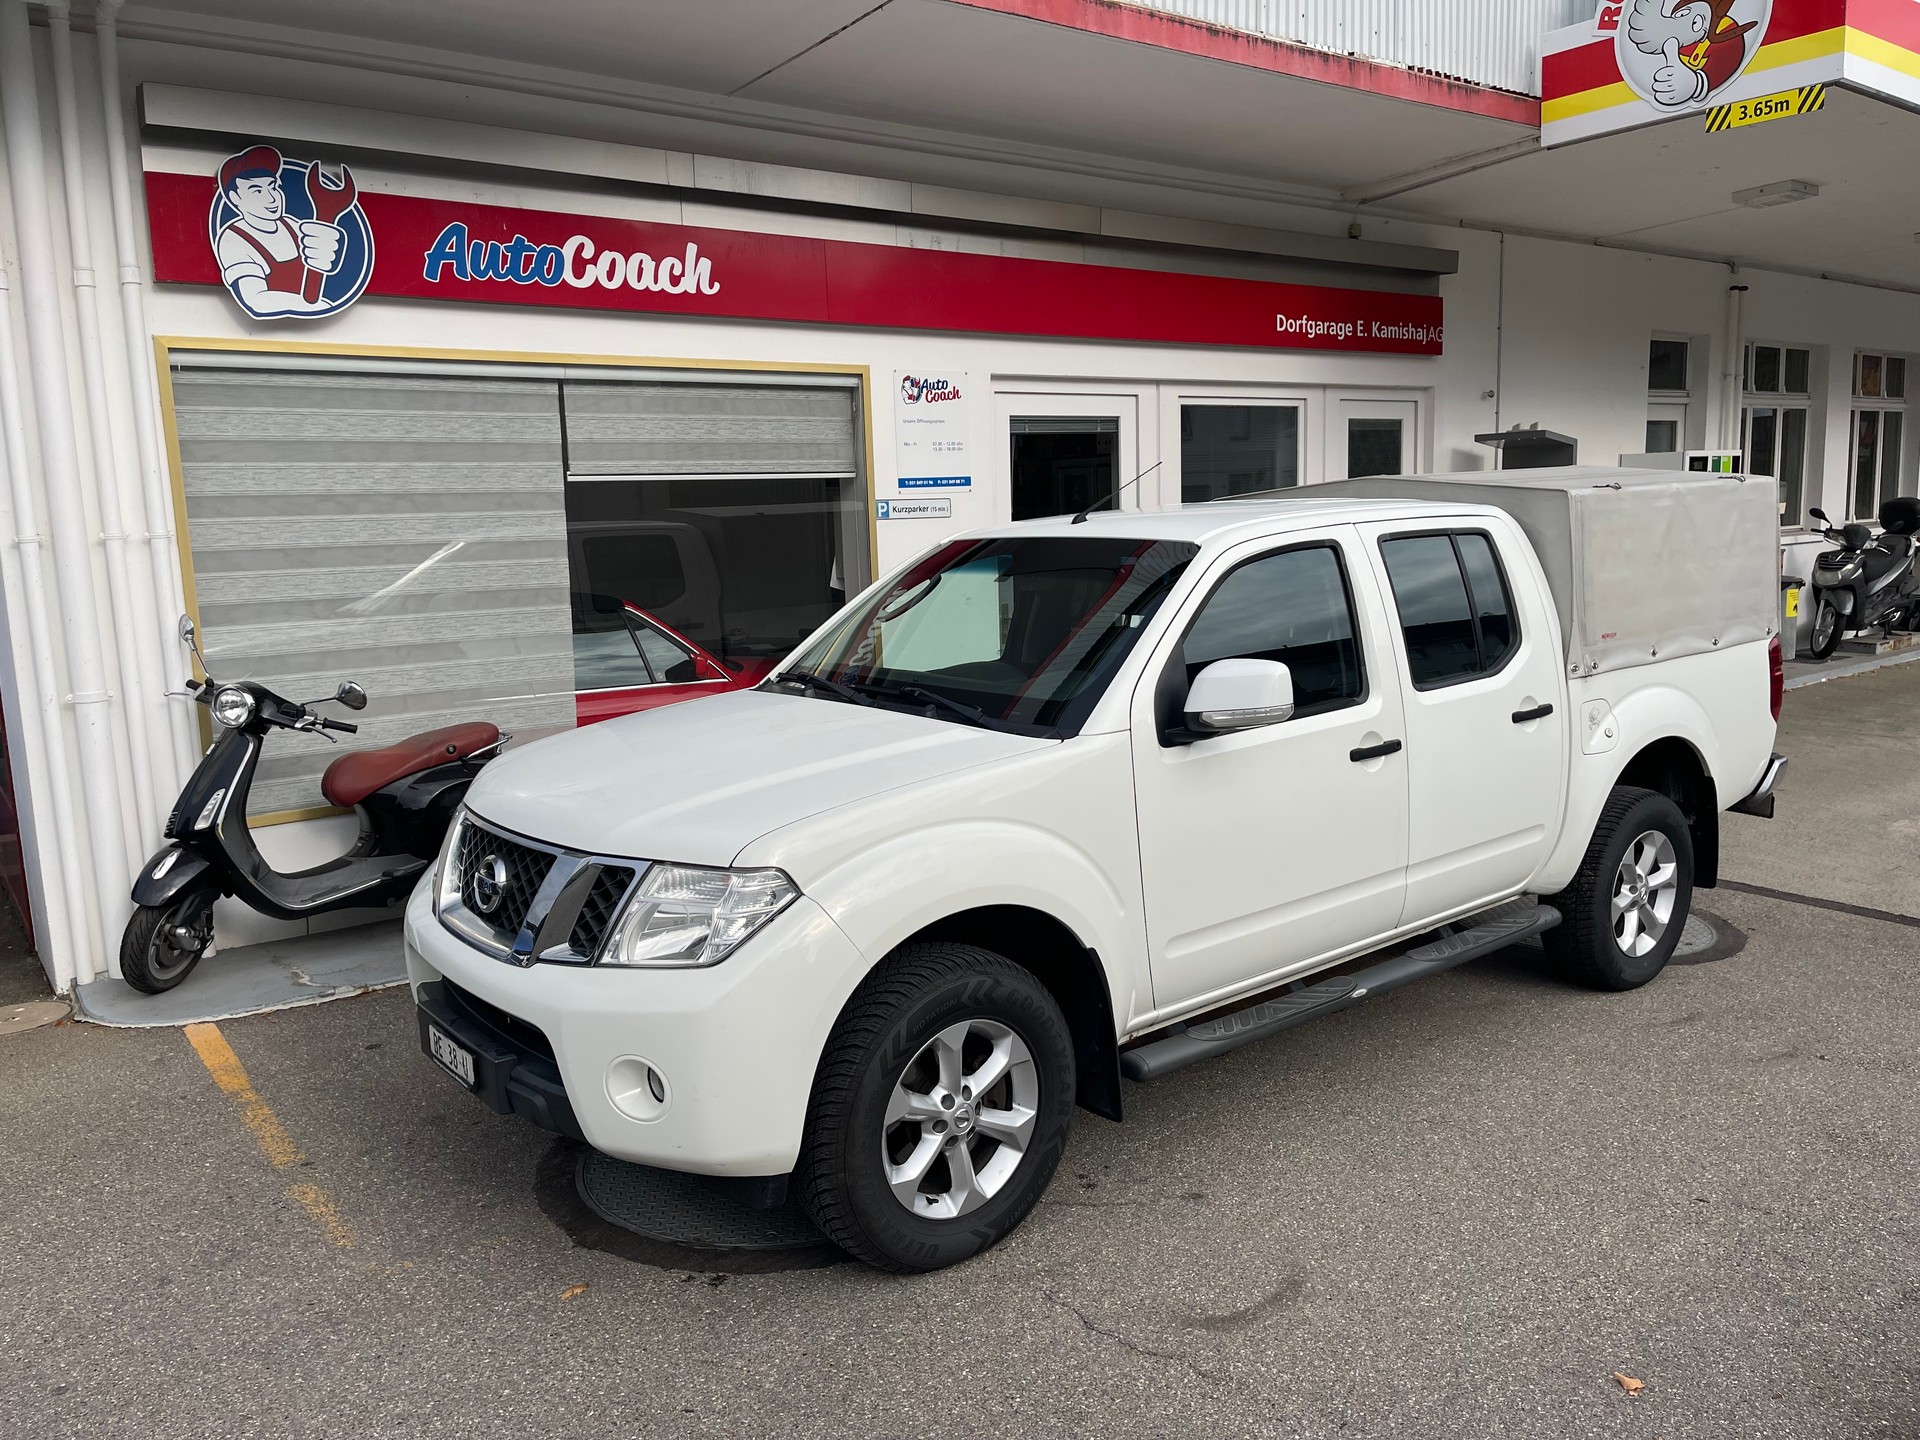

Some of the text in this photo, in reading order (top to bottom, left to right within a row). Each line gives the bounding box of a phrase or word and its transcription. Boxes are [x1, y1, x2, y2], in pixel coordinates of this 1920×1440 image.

[1597, 0, 1624, 30] R
[1738, 97, 1791, 121] 3.65m
[1276, 314, 1443, 344] Dorfgarage E. Kamishaj AG
[920, 378, 949, 394] Auto
[925, 385, 962, 403] Coach
[877, 503, 888, 517] P
[892, 505, 929, 514] Kurzparker
[913, 997, 957, 1034] ROTATION
